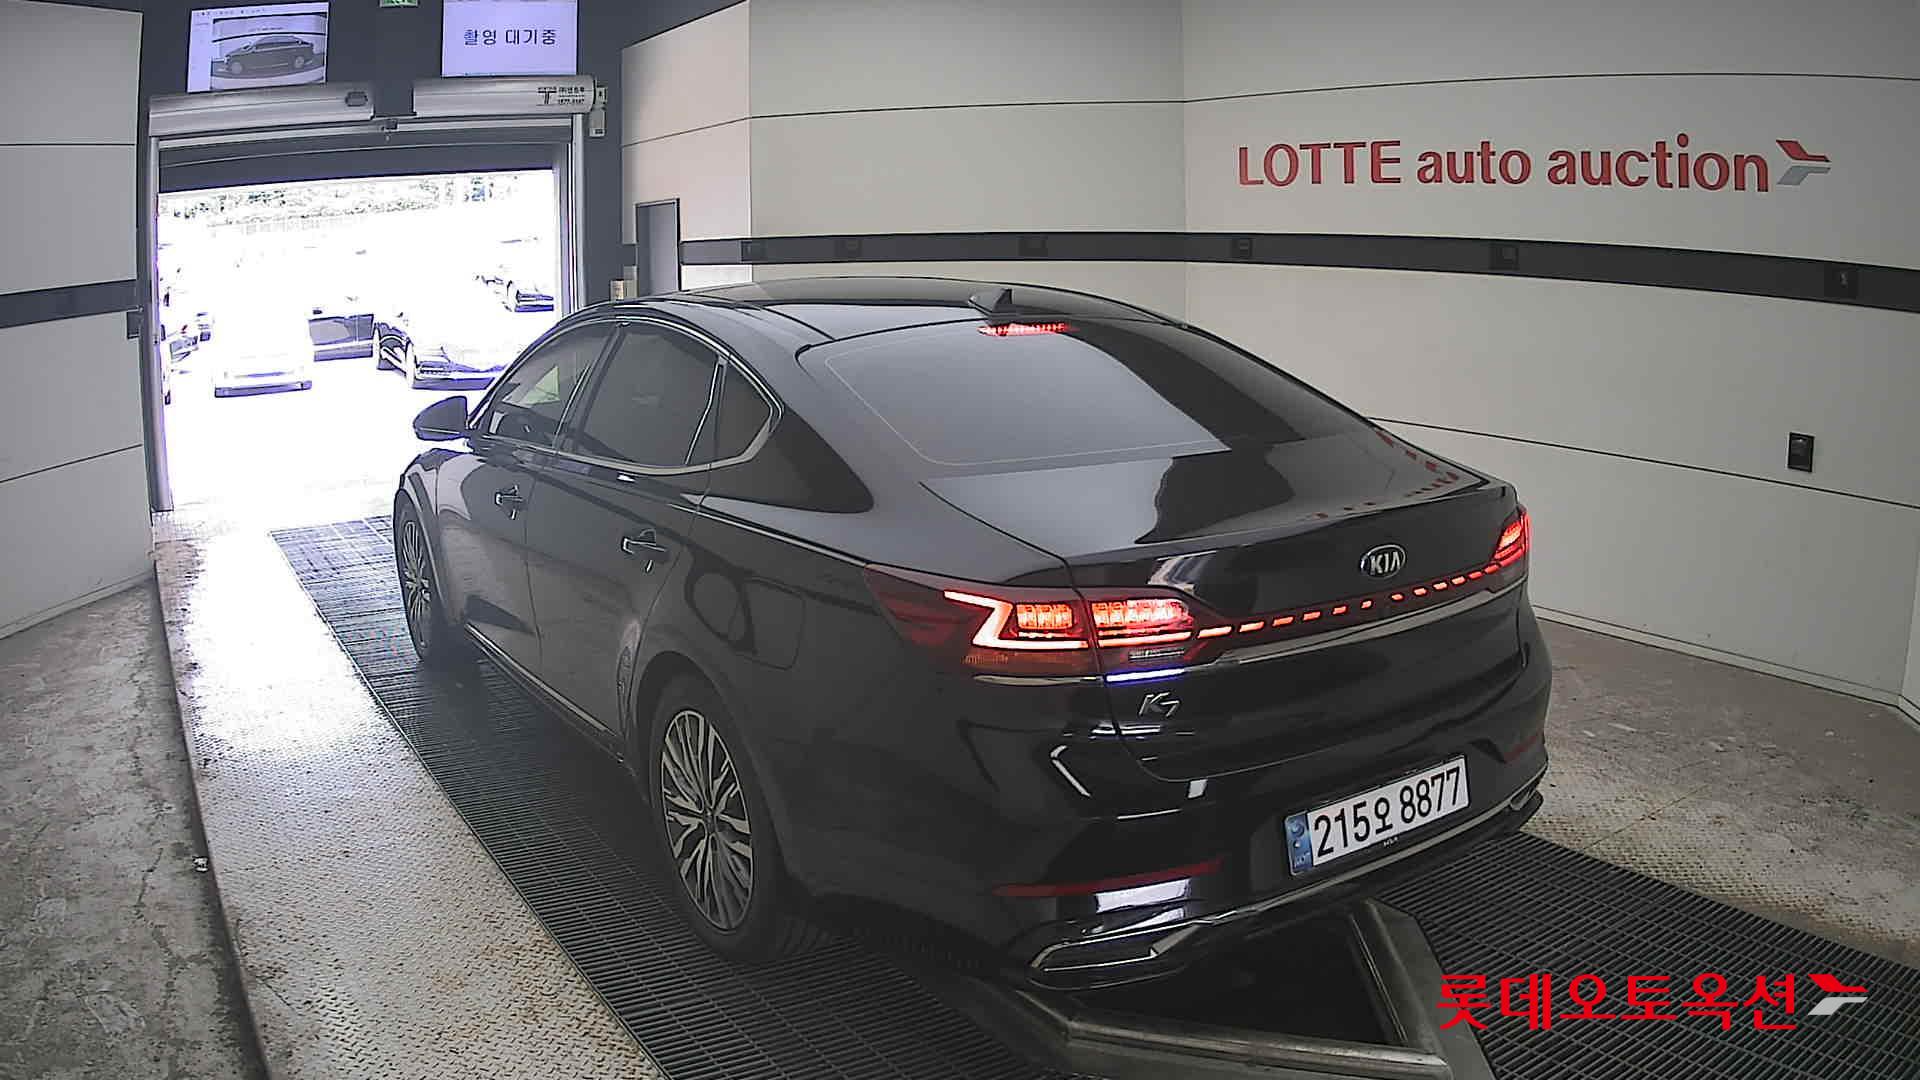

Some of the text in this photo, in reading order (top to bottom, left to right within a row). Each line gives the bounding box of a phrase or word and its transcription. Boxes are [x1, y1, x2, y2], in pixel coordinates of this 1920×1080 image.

[464, 28, 556, 46] 촬영 대기중
[1238, 133, 1769, 193] LOTTE auto auction
[1369, 551, 1401, 576] KIA
[1138, 691, 1180, 717] K7
[1313, 766, 1461, 858] 215오 8877
